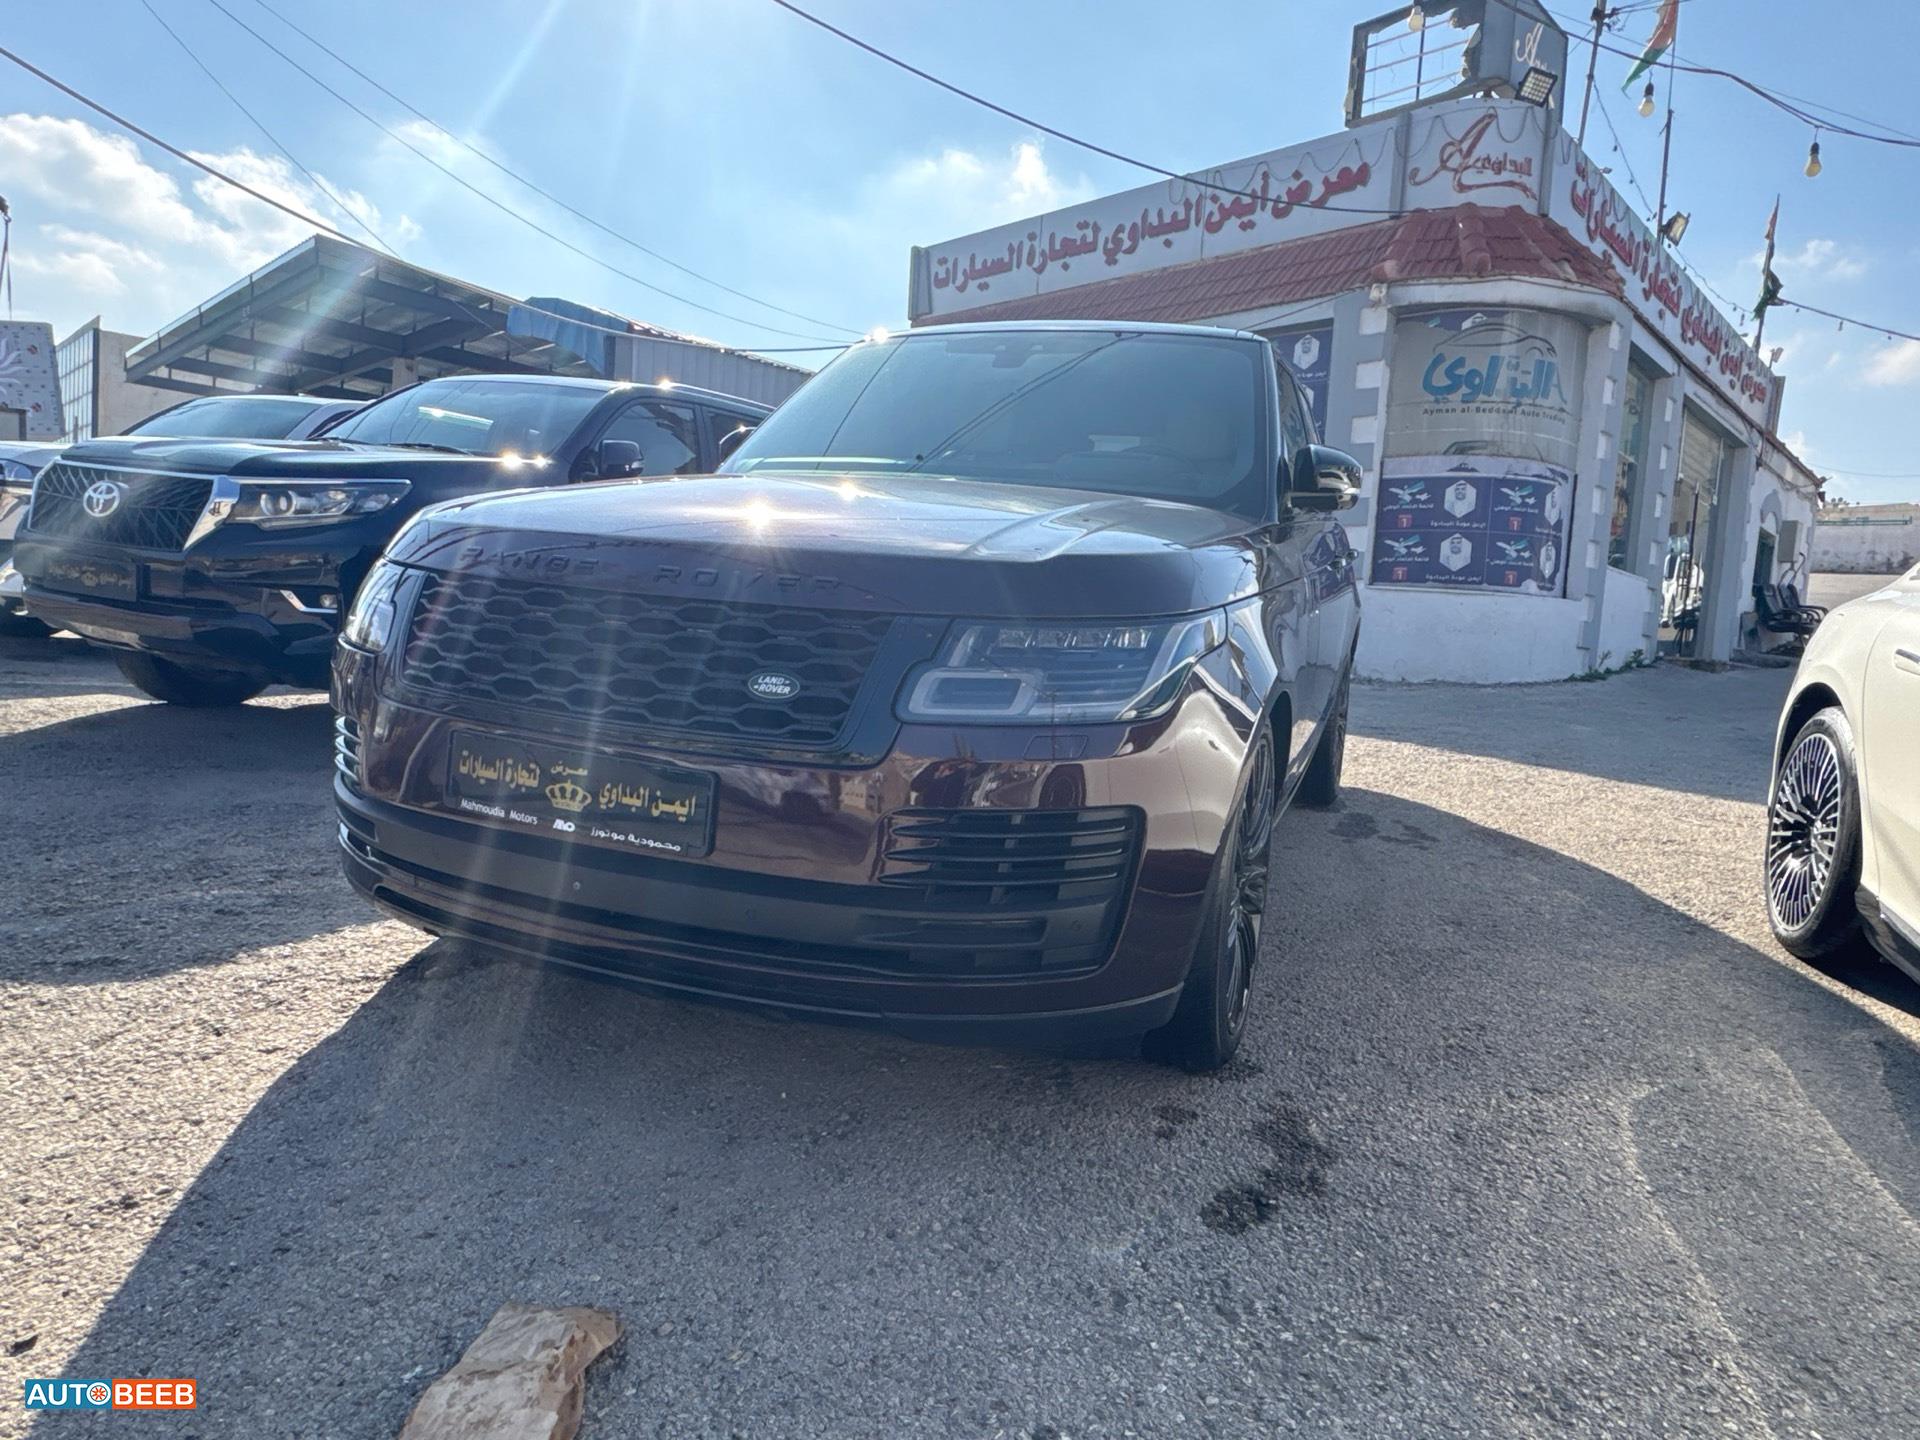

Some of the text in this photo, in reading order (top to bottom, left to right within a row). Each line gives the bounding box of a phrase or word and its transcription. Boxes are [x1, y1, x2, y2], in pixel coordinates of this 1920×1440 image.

[1270, 162, 1372, 219] معرض
[1026, 220, 1101, 275] لتجارة
[1102, 193, 1203, 266] البداوي
[934, 241, 1024, 293] السيارات
[758, 676, 785, 685] LAND
[758, 684, 791, 694] ROVER
[459, 750, 696, 822] ايمن البداوي لتجارة السيارات
[460, 798, 538, 825] Mahmoudia Motors
[627, 833, 681, 852] محمودية
